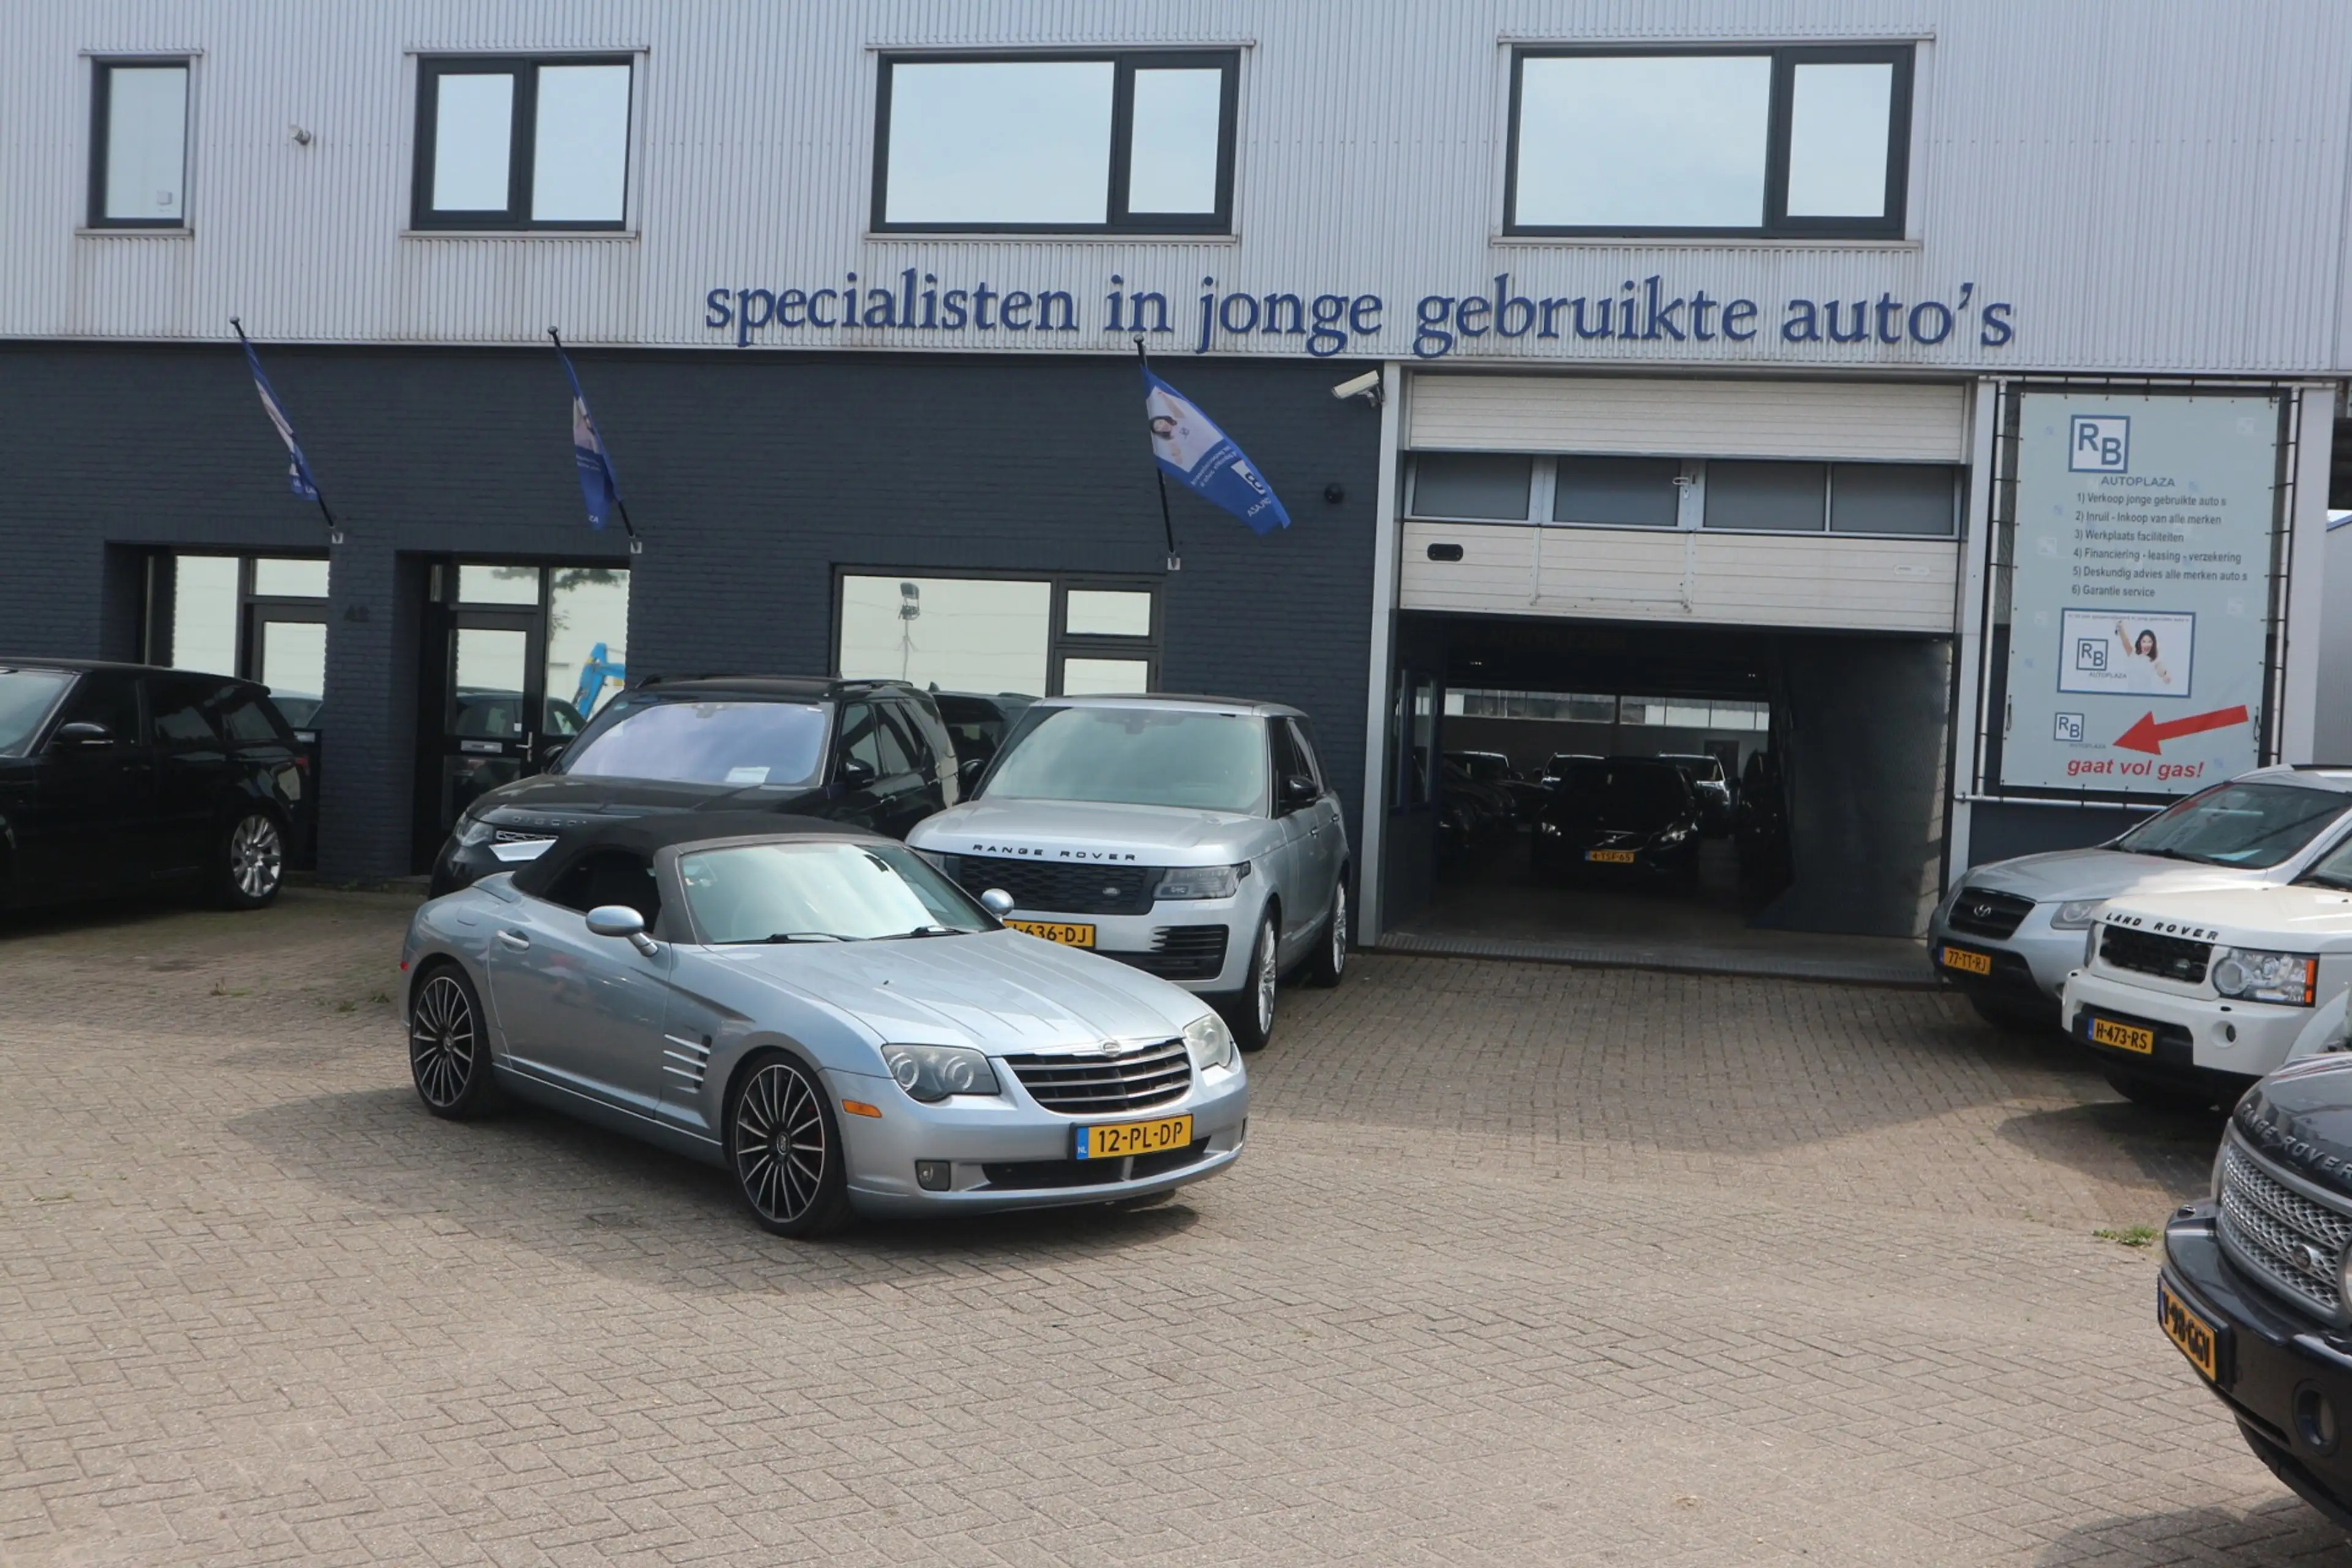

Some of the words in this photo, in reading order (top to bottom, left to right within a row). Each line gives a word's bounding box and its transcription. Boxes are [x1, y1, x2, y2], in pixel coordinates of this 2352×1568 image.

[705, 268, 1079, 347] specialisten
[1106, 275, 1170, 333] in
[1195, 276, 1383, 356] jonge
[1412, 274, 1758, 358] gebruikte
[1782, 282, 2013, 347] auto's
[2078, 423, 2122, 466] RB
[2101, 475, 2176, 487] AUTOPLAZA
[2087, 492, 2124, 505] Verkoop
[2125, 494, 2152, 507] jonge
[2154, 495, 2196, 507] gebruikte
[2086, 511, 2109, 521] Inruil
[2117, 512, 2148, 525] Inkoop
[2169, 513, 2185, 524] alle
[2187, 514, 2222, 525] merken
[2086, 529, 2135, 543] Werkplaats
[2137, 530, 2184, 543] faciliteiten
[2084, 548, 2140, 562] Financiering
[2148, 549, 2180, 563] leasing
[2188, 551, 2242, 565] verzekering
[2084, 566, 2131, 580] Deskundig
[2133, 568, 2163, 579] advies
[2165, 569, 2181, 579] alle
[2184, 570, 2217, 581] merken
[2083, 584, 2120, 596] Garantie
[2122, 587, 2155, 597] service
[2081, 643, 2105, 666] RB
[2059, 717, 2080, 737] RB
[2067, 758, 2115, 776] gaat
[2120, 760, 2150, 775] vol
[2157, 761, 2205, 780] gas!
[973, 844, 1044, 856] RANGE
[1060, 851, 1136, 861] ROVER
[1005, 923, 1086, 943] -636-DJ
[2106, 913, 2142, 926] LAND
[2154, 922, 2218, 940] ROVER
[2096, 1022, 2147, 1050] H-473-RS
[1099, 1121, 1183, 1152] 12-PL-DP
